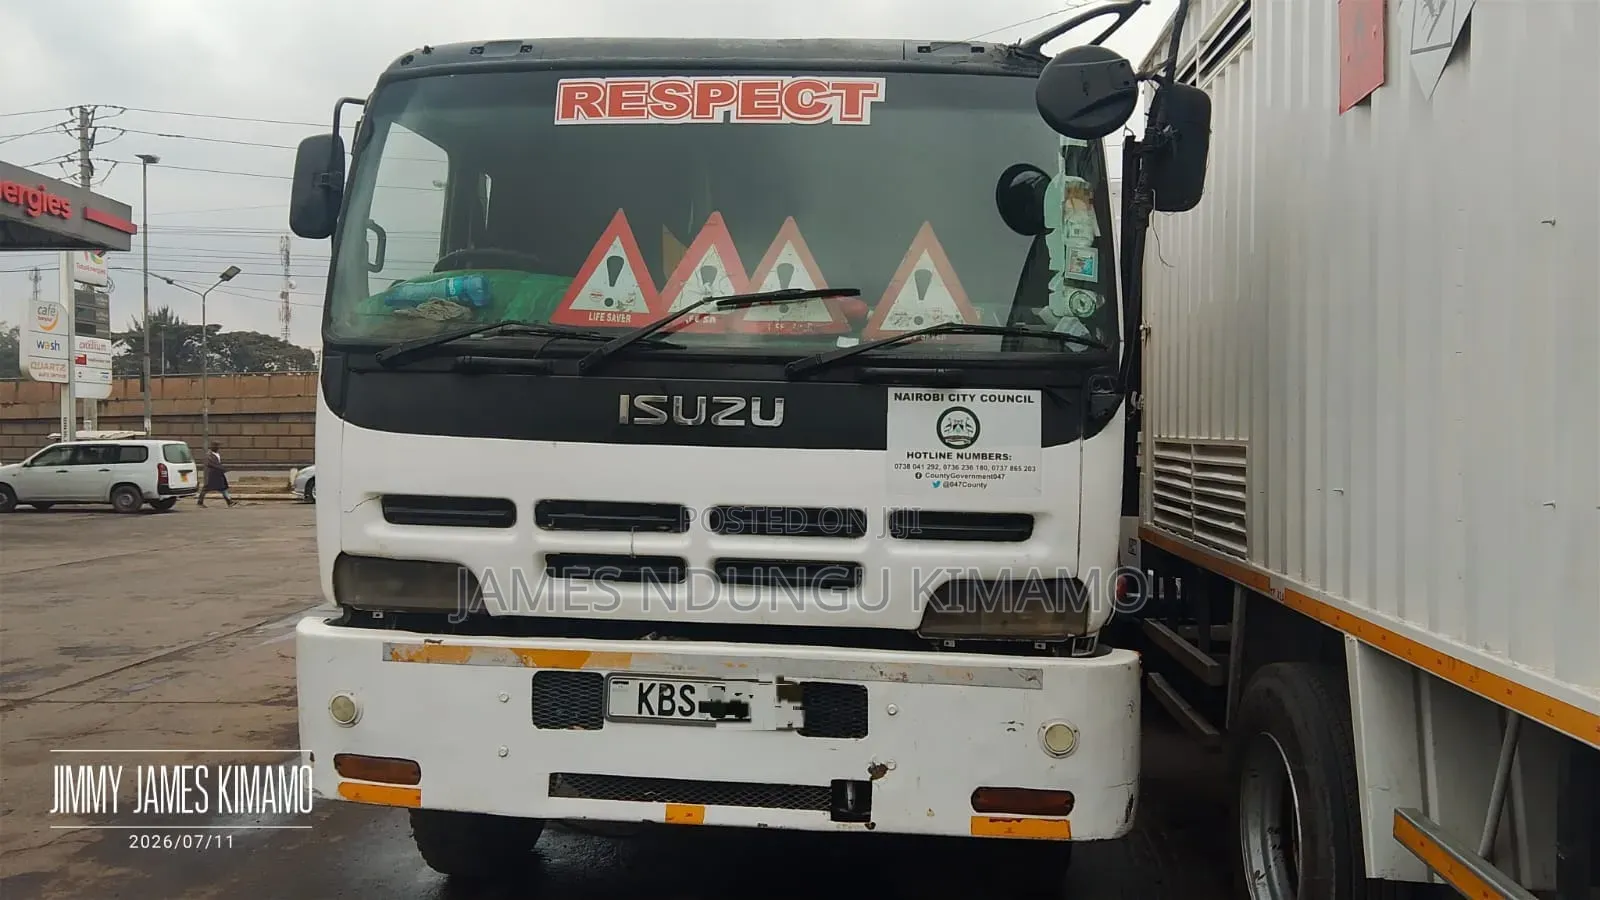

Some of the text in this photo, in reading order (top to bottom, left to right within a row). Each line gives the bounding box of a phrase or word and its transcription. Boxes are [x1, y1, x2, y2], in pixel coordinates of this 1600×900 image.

[557, 78, 880, 121] RESPECT
[0, 181, 73, 219] ergies
[588, 311, 632, 323] LIFE SAVER
[894, 392, 1035, 404] NAIROBI CITY COUNCIL
[619, 394, 785, 427] ISUZU
[906, 451, 1012, 461] HOTLINE NUMBERS:
[925, 472, 1005, 481] CountyGovernment047
[942, 481, 988, 489] @047County
[638, 682, 696, 717] KBS
